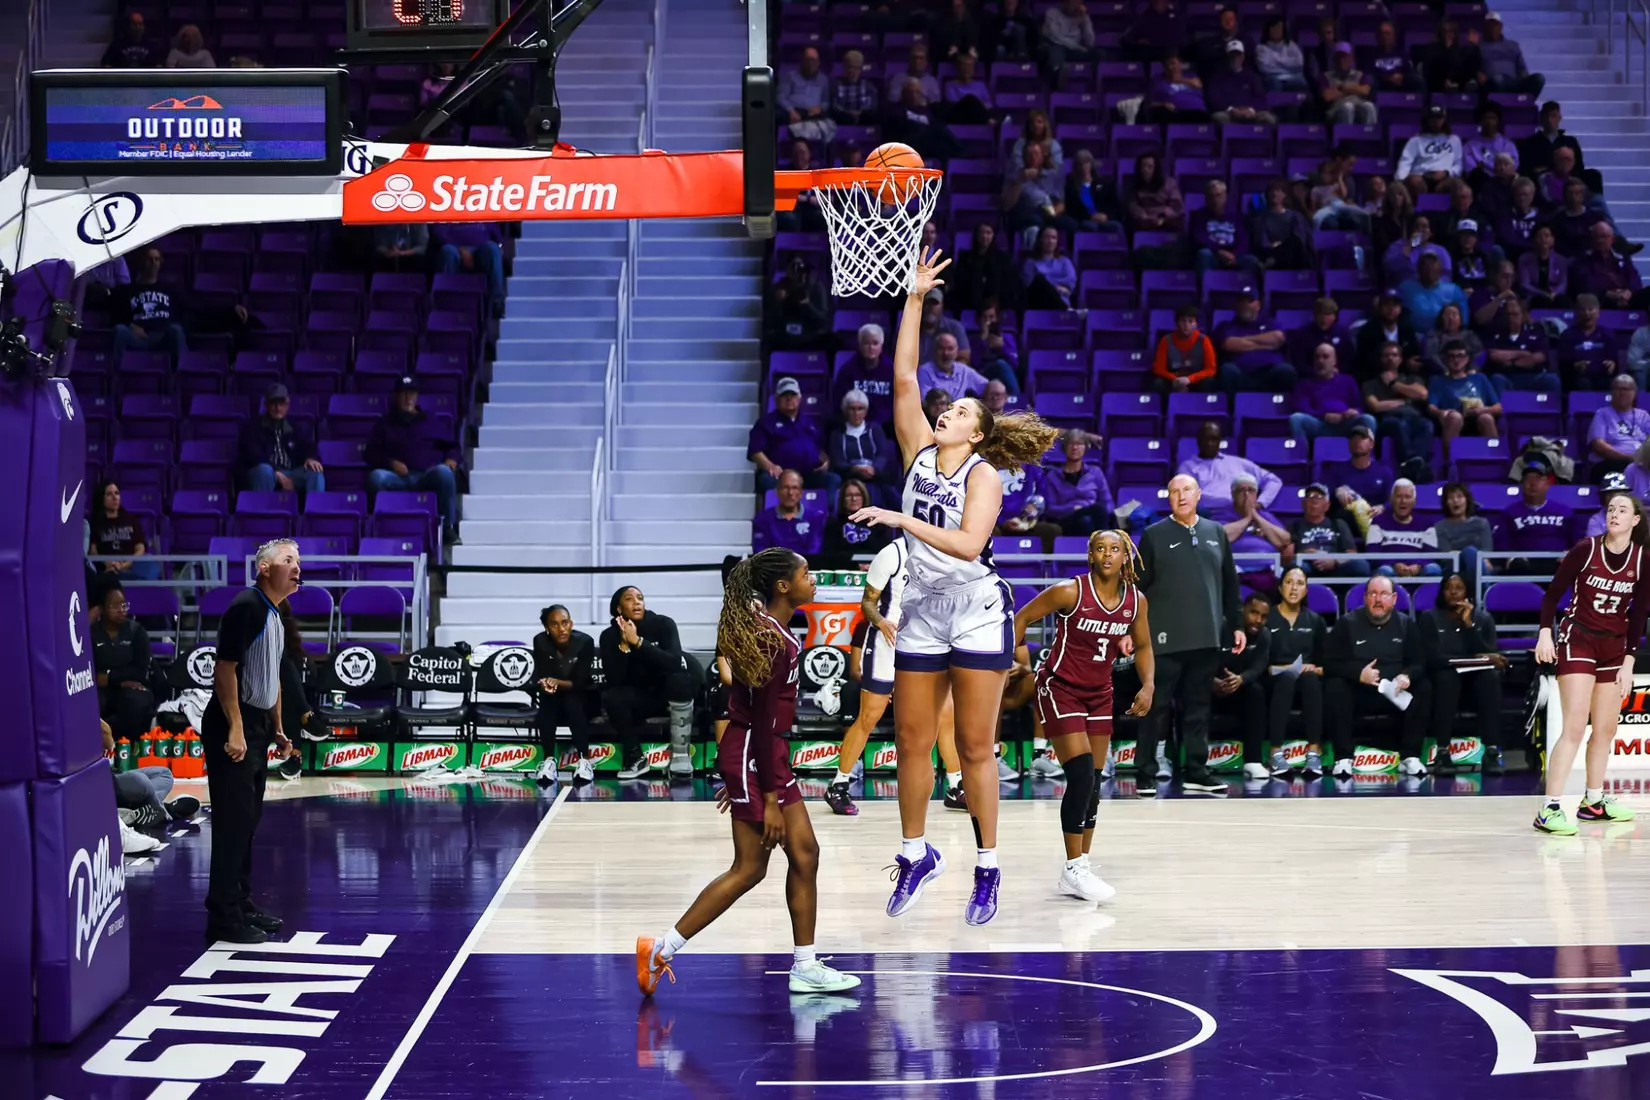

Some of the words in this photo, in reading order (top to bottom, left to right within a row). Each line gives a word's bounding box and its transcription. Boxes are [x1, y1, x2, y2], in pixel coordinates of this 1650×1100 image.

[127, 118, 243, 138] OUTDOOR
[119, 150, 149, 158] Member
[149, 150, 169, 158] FDIC
[173, 150, 195, 159] Equal
[195, 150, 226, 159] Housing
[226, 150, 253, 158] Lender
[159, 142, 212, 151] BANK
[130, 291, 170, 307] K-STATE
[912, 473, 958, 507] Wildcats
[913, 499, 946, 529] 50
[1514, 515, 1564, 530] K-STATE
[1586, 575, 1614, 591] LITTLE
[1612, 581, 1636, 593] ROCK
[1593, 592, 1622, 614] 23
[1077, 618, 1109, 634] LITTLE
[1092, 638, 1110, 662] 3
[409, 654, 462, 671] Capitol
[792, 745, 843, 768] LIBMAN
[1209, 744, 1240, 760] MAN
[1614, 738, 1650, 755] M
[322, 745, 375, 769] LIBMAN
[402, 745, 454, 769] LIBMAN
[480, 746, 532, 769] LIBMAN
[559, 746, 611, 768] LIBAN
[873, 749, 898, 768] LIB
[69, 835, 125, 961] Dillons
